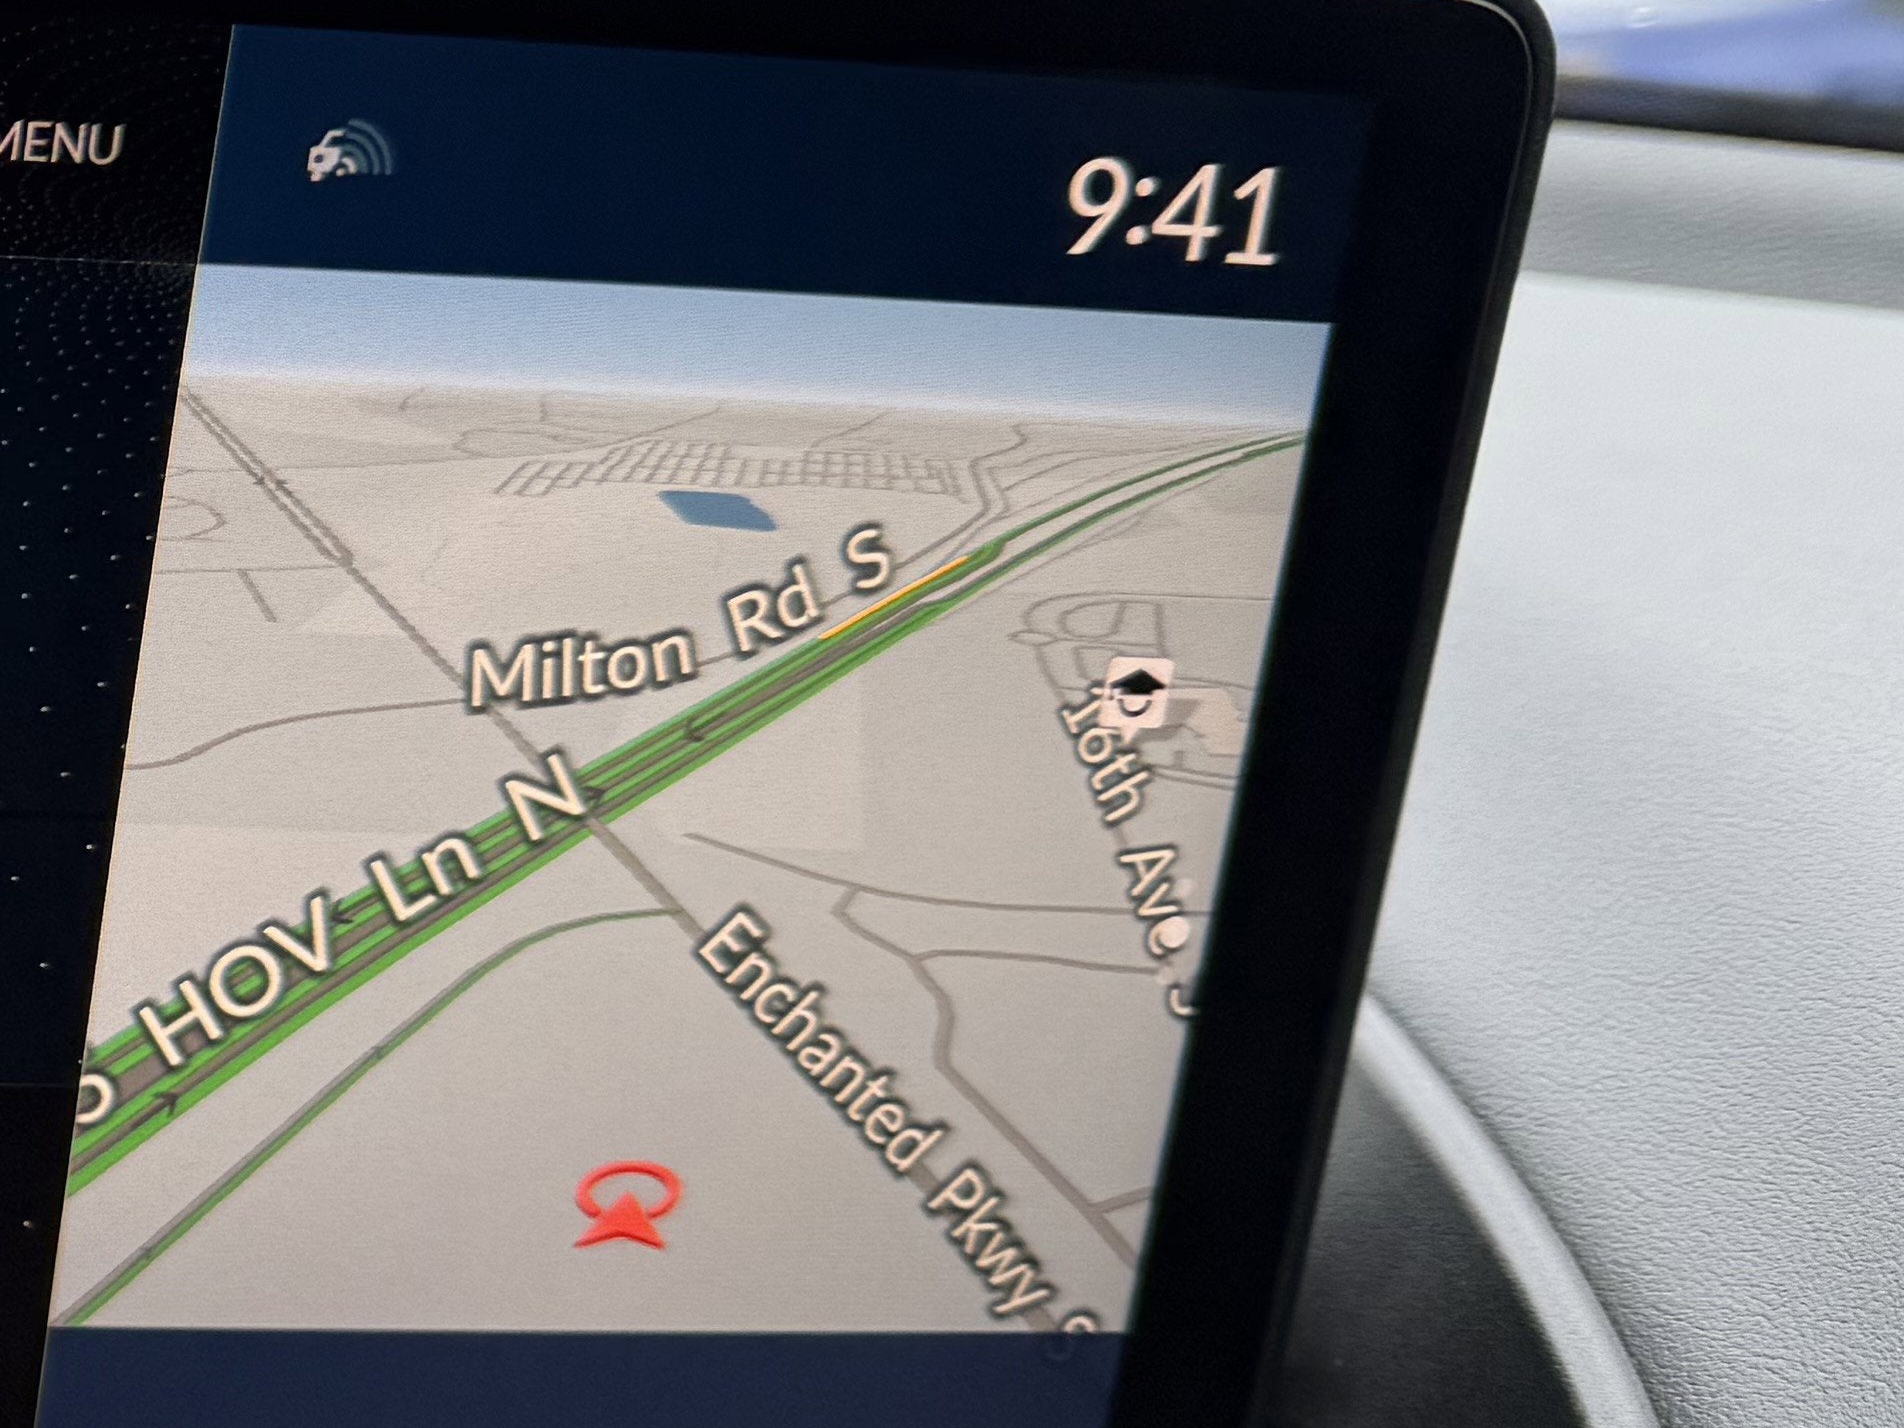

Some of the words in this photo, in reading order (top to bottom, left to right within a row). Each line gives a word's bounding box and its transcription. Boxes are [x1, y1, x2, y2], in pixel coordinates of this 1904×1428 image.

[1067, 158, 1276, 265] 9:41
[471, 634, 692, 707] Milton
[727, 563, 818, 652] Rd
[846, 528, 890, 590] S
[138, 896, 328, 1066] HOV
[370, 832, 483, 923] Ln
[505, 754, 585, 841] N
[699, 912, 944, 1172] Enchanted
[927, 1168, 1050, 1315] Pkwy
